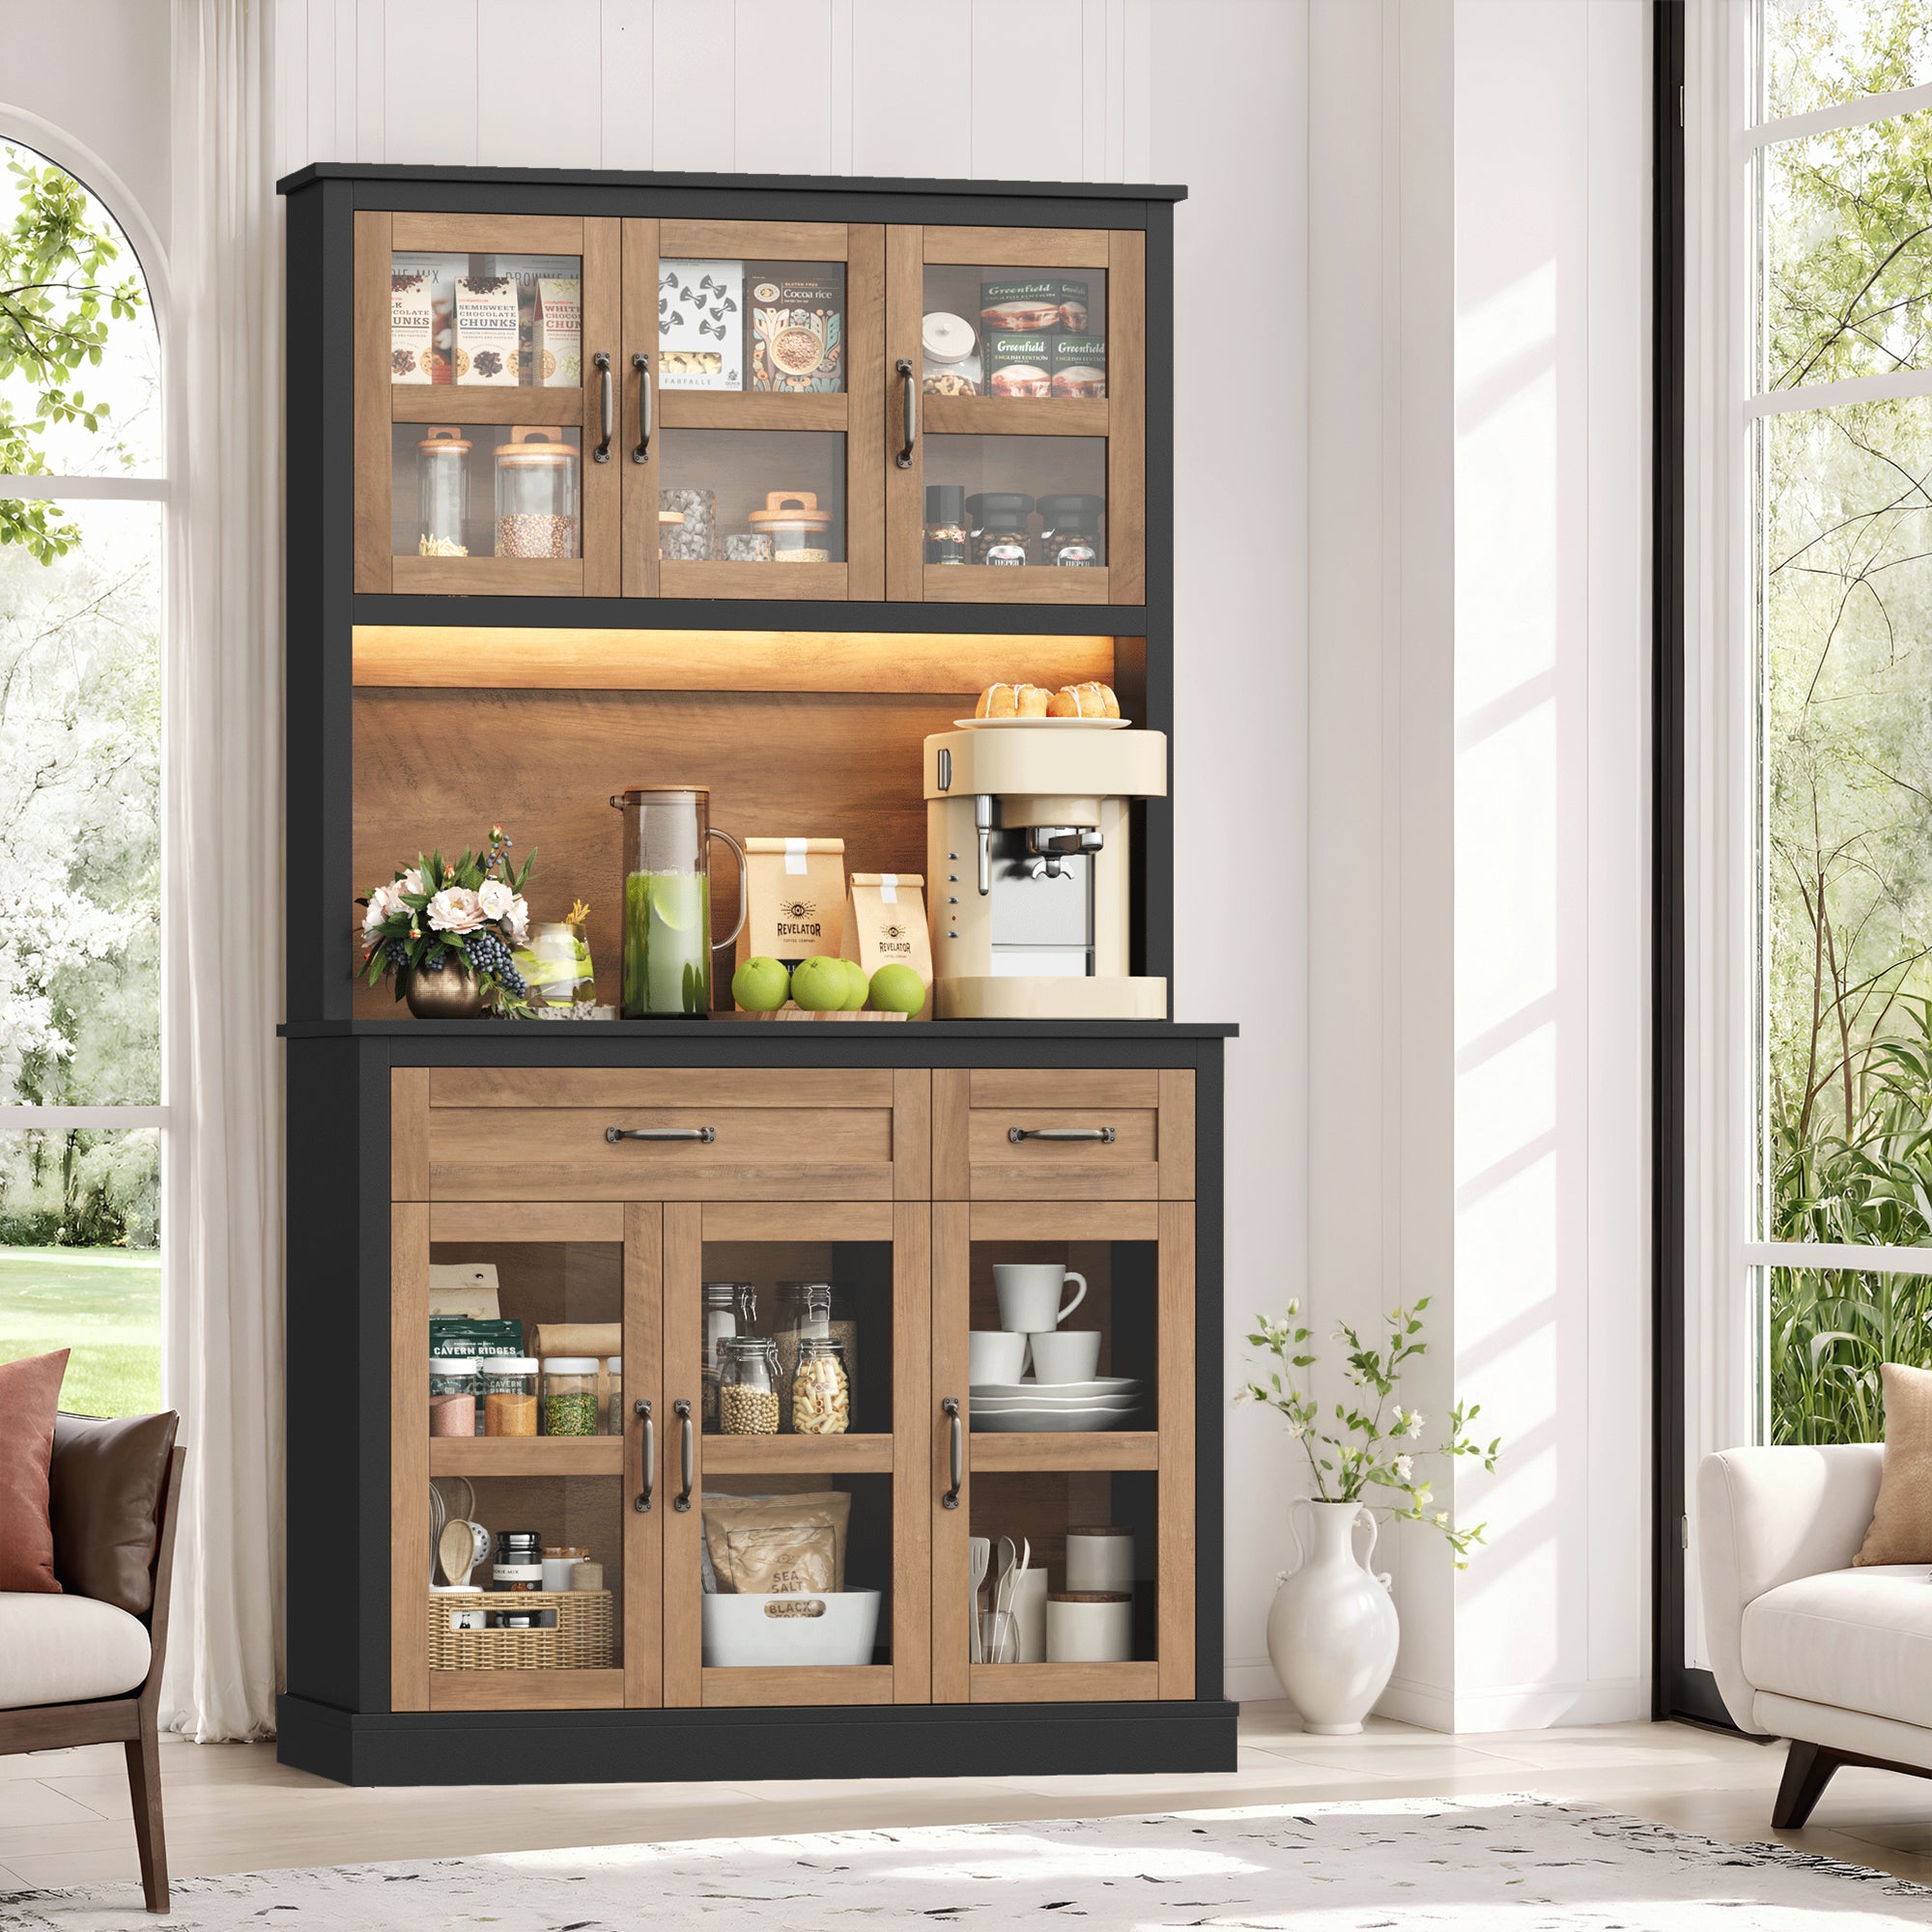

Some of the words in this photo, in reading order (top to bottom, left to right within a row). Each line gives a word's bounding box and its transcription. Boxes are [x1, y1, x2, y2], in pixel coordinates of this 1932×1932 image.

[783, 289, 813, 298] Cocoa
[814, 290, 833, 299] rice
[988, 284, 1051, 296] Greenfield
[460, 318, 517, 327] CHUNKS
[997, 340, 1045, 354] Greenfield
[1058, 341, 1105, 354] Greenfield
[777, 923, 821, 937] REVELATOR
[879, 941, 912, 954] REVELATOR
[434, 1347, 476, 1355] CAVERN
[478, 1347, 517, 1355] RIDGES
[773, 1570, 799, 1582] SEA
[771, 1580, 804, 1594] SALT
[769, 1602, 811, 1614] BLACK
